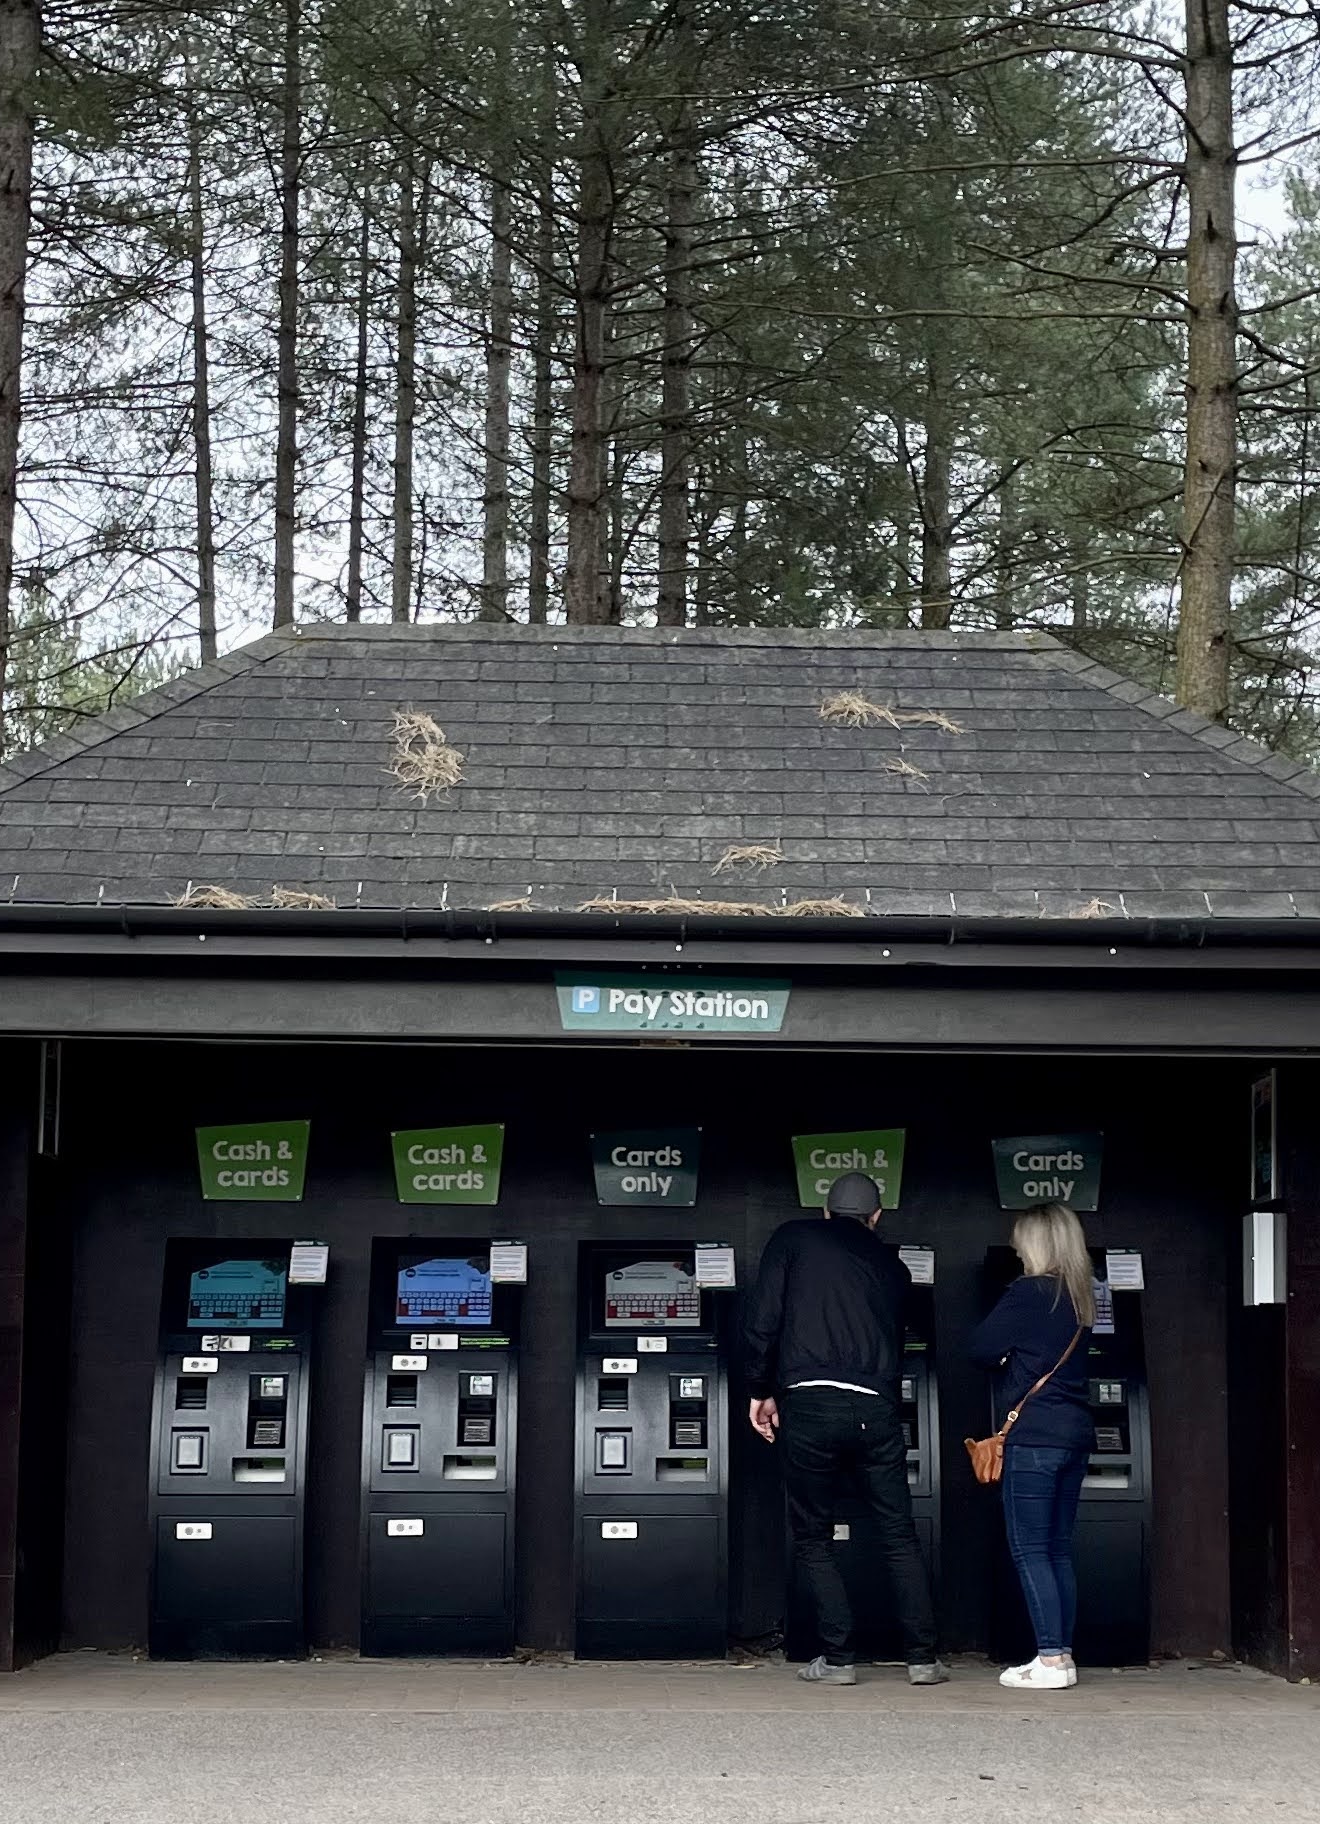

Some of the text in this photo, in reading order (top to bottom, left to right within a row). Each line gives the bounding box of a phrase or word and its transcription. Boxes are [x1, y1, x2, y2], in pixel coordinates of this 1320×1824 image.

[609, 989, 663, 1020] Pay
[669, 990, 769, 1019] Station
[212, 1140, 293, 1161] Cash &
[407, 1143, 488, 1165] Cash &
[611, 1145, 683, 1167] Cards
[809, 1148, 889, 1169] Cash &
[1012, 1150, 1085, 1172] Cards
[217, 1166, 290, 1187] cards
[412, 1170, 485, 1191] cards
[621, 1171, 673, 1197] only
[1022, 1176, 1075, 1202] only
